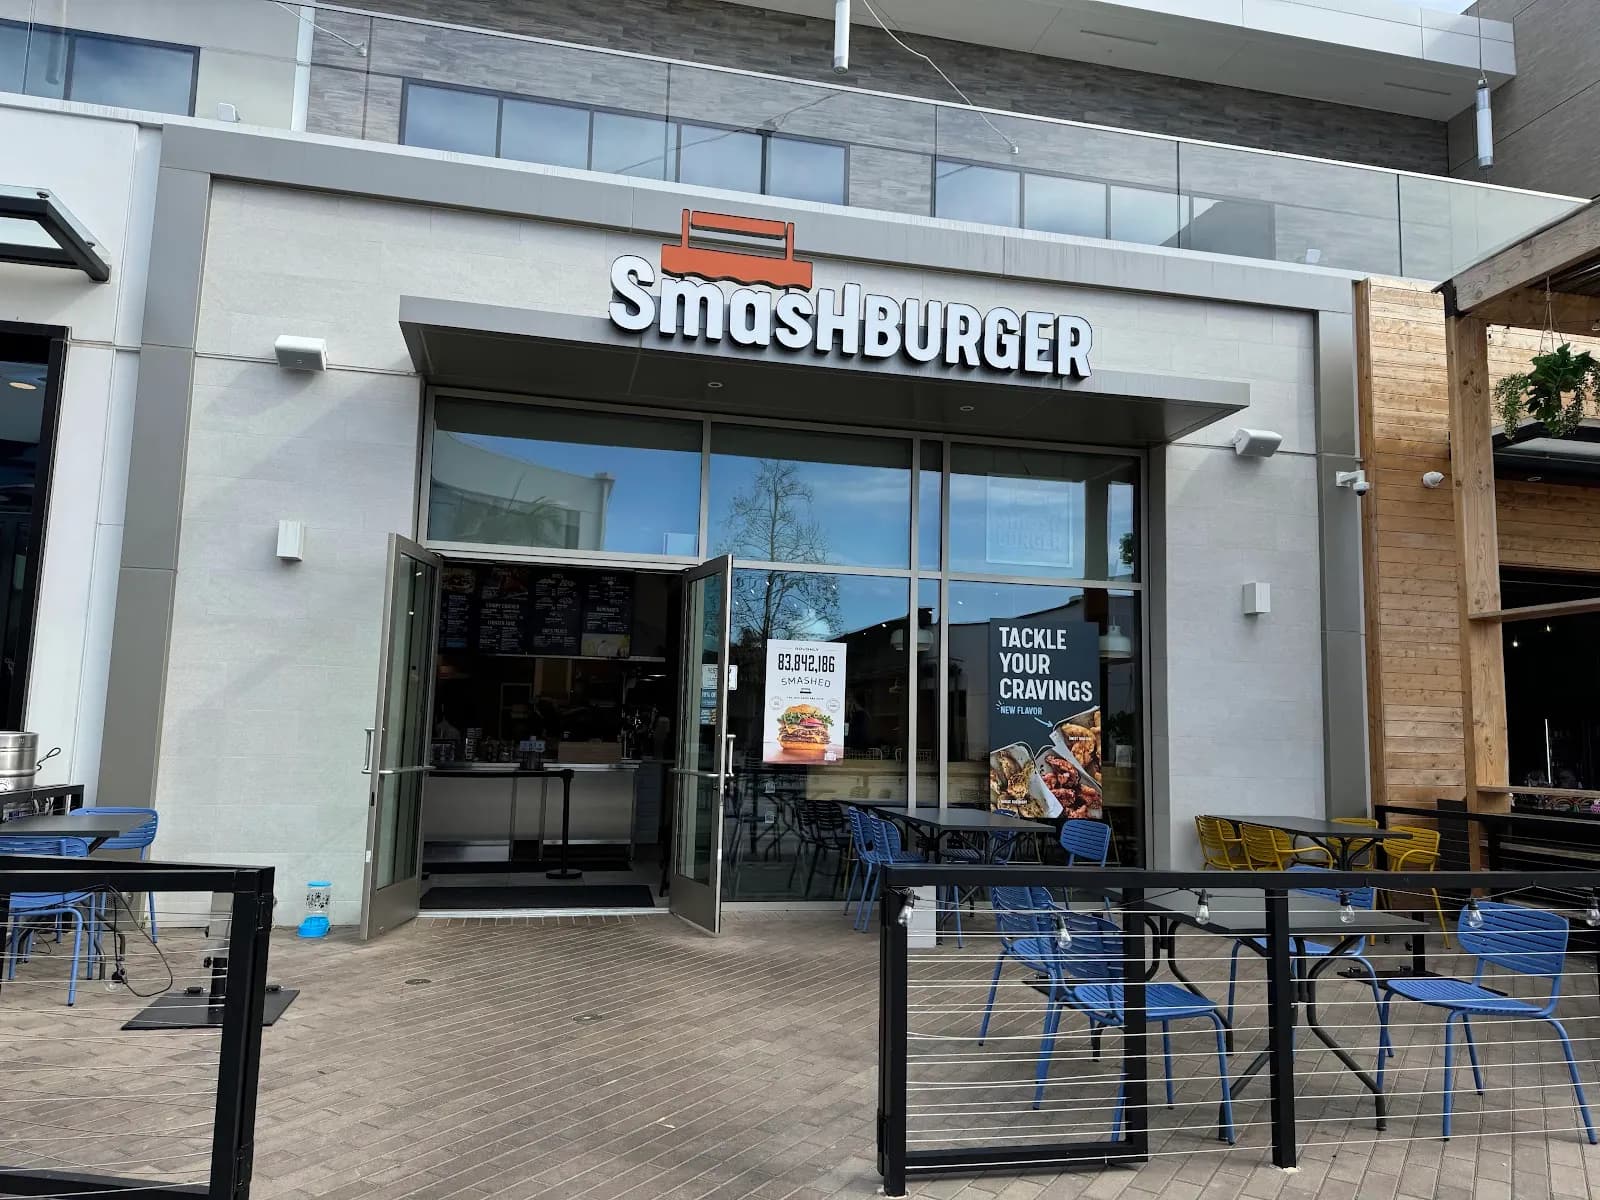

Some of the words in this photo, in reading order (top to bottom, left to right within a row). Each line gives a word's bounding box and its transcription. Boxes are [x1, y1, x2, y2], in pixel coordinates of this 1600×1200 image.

[999, 626, 1067, 650] TACKLE
[777, 653, 835, 673] 83,842,186
[999, 652, 1050, 675] YOUR
[781, 676, 831, 688] SMASHED
[999, 678, 1093, 702] CRAVINGS
[1000, 705, 1016, 715] NEW
[1017, 706, 1043, 716] FLAVOR
